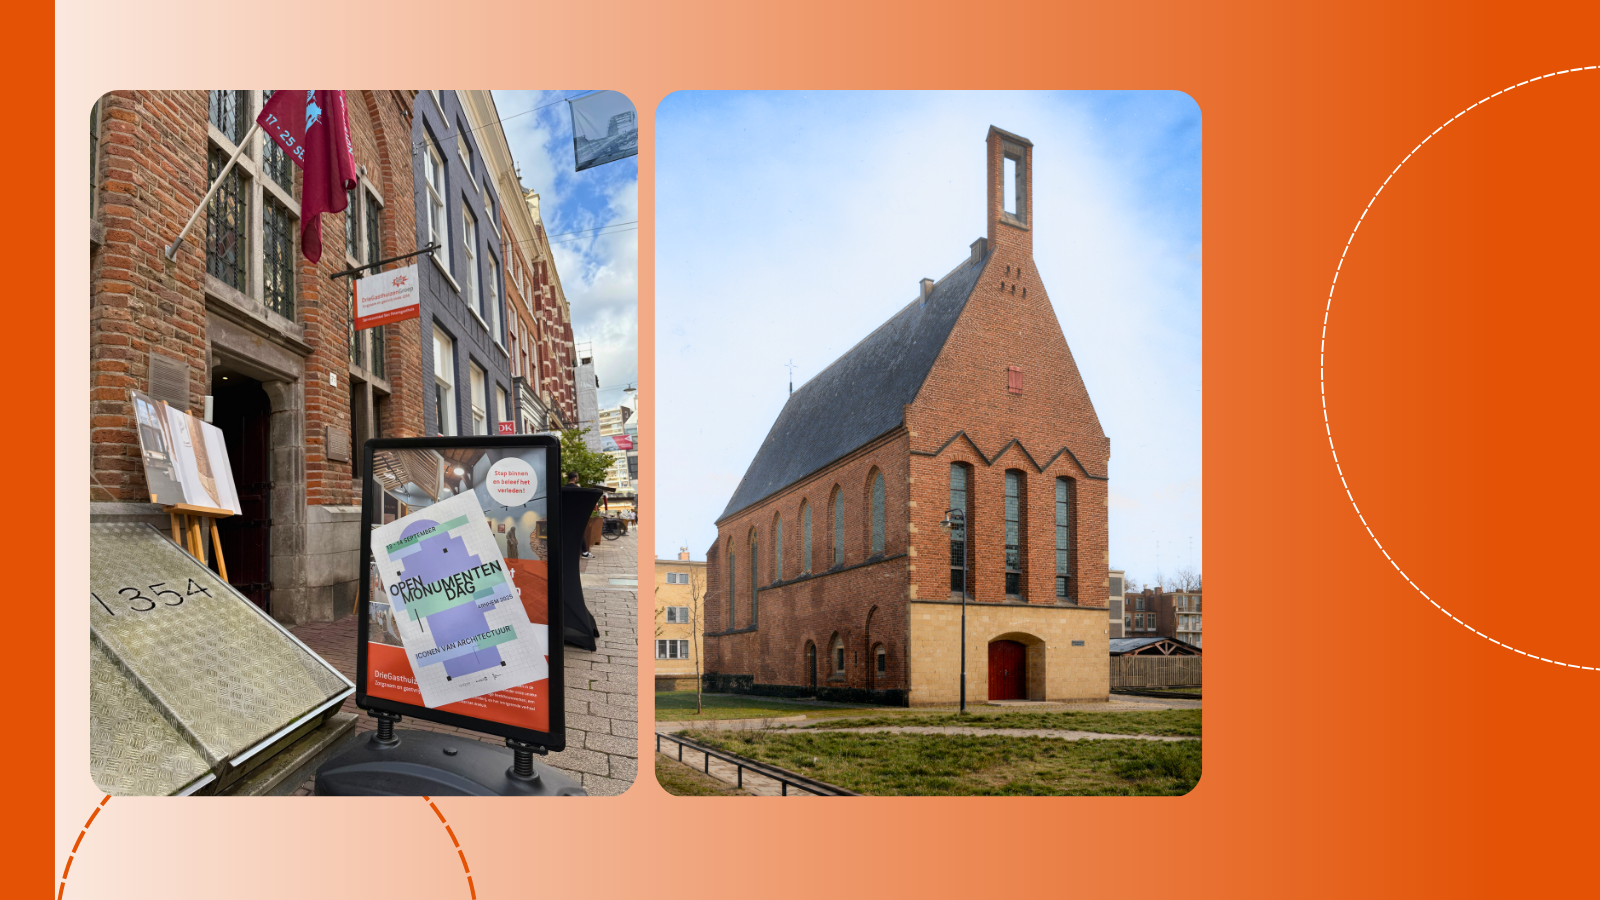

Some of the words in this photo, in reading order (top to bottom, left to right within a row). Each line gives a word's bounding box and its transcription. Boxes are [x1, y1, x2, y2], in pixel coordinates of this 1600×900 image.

[265, 113, 278, 126] 17
[280, 130, 296, 147] 25
[404, 526, 436, 543] SEPTEMBER
[390, 575, 424, 597] OPEN
[401, 560, 503, 605] MONUMENTEN
[444, 582, 476, 601] DAG
[91, 578, 213, 616] 1354
[415, 647, 441, 660] ICONEN
[441, 642, 457, 652] VAN
[457, 625, 512, 648] ARCHITECTUUR
[375, 680, 396, 689] Zorgzaam
